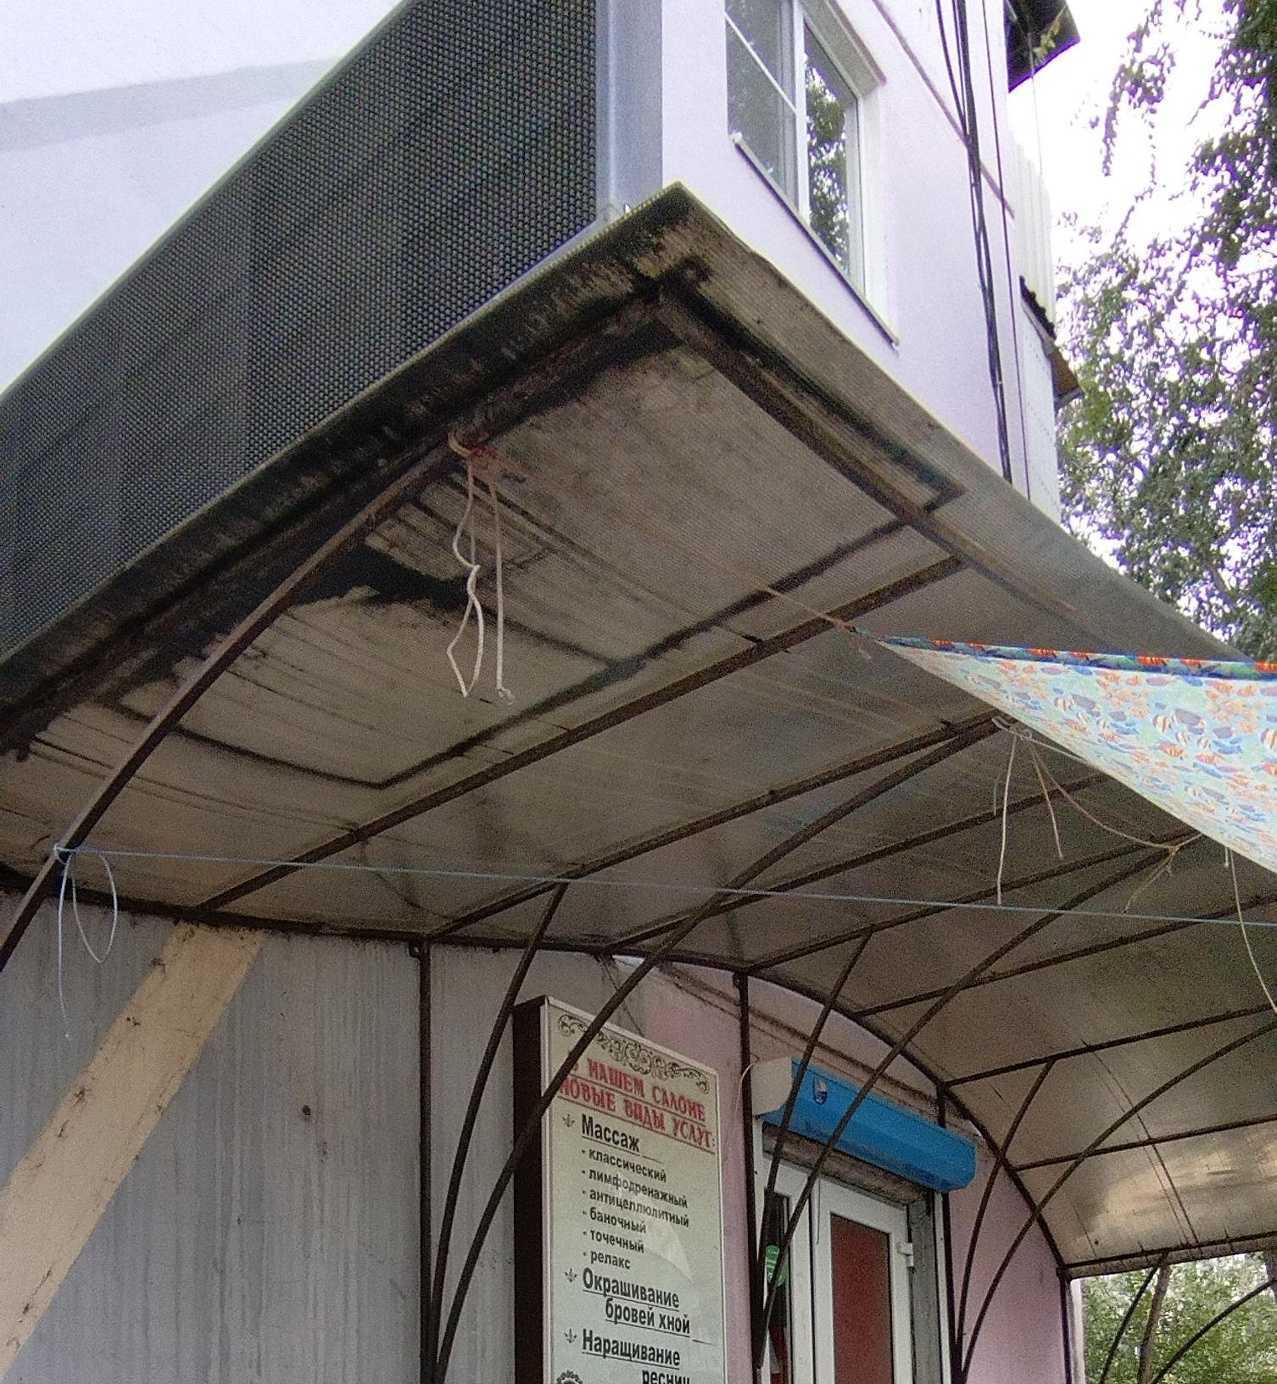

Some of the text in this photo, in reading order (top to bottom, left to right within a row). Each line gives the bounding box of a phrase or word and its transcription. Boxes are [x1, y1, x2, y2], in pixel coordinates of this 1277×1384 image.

[587, 1058, 706, 1122] НАШЕМ САЛОНЕ
[560, 1077, 716, 1148] НОВЫЕ ВИДЫ УСЛУГ:
[581, 1113, 641, 1152] Массаж
[588, 1148, 667, 1183] классический
[588, 1169, 689, 1209] лимфодренажный
[589, 1190, 690, 1227] антицеллюлитный
[589, 1206, 647, 1233] баночный
[589, 1228, 645, 1254] точечный
[590, 1250, 631, 1270] релакс
[582, 1266, 680, 1309] Окрашивание
[604, 1297, 691, 1335] бровей хной
[582, 1328, 681, 1367] Наращивание
